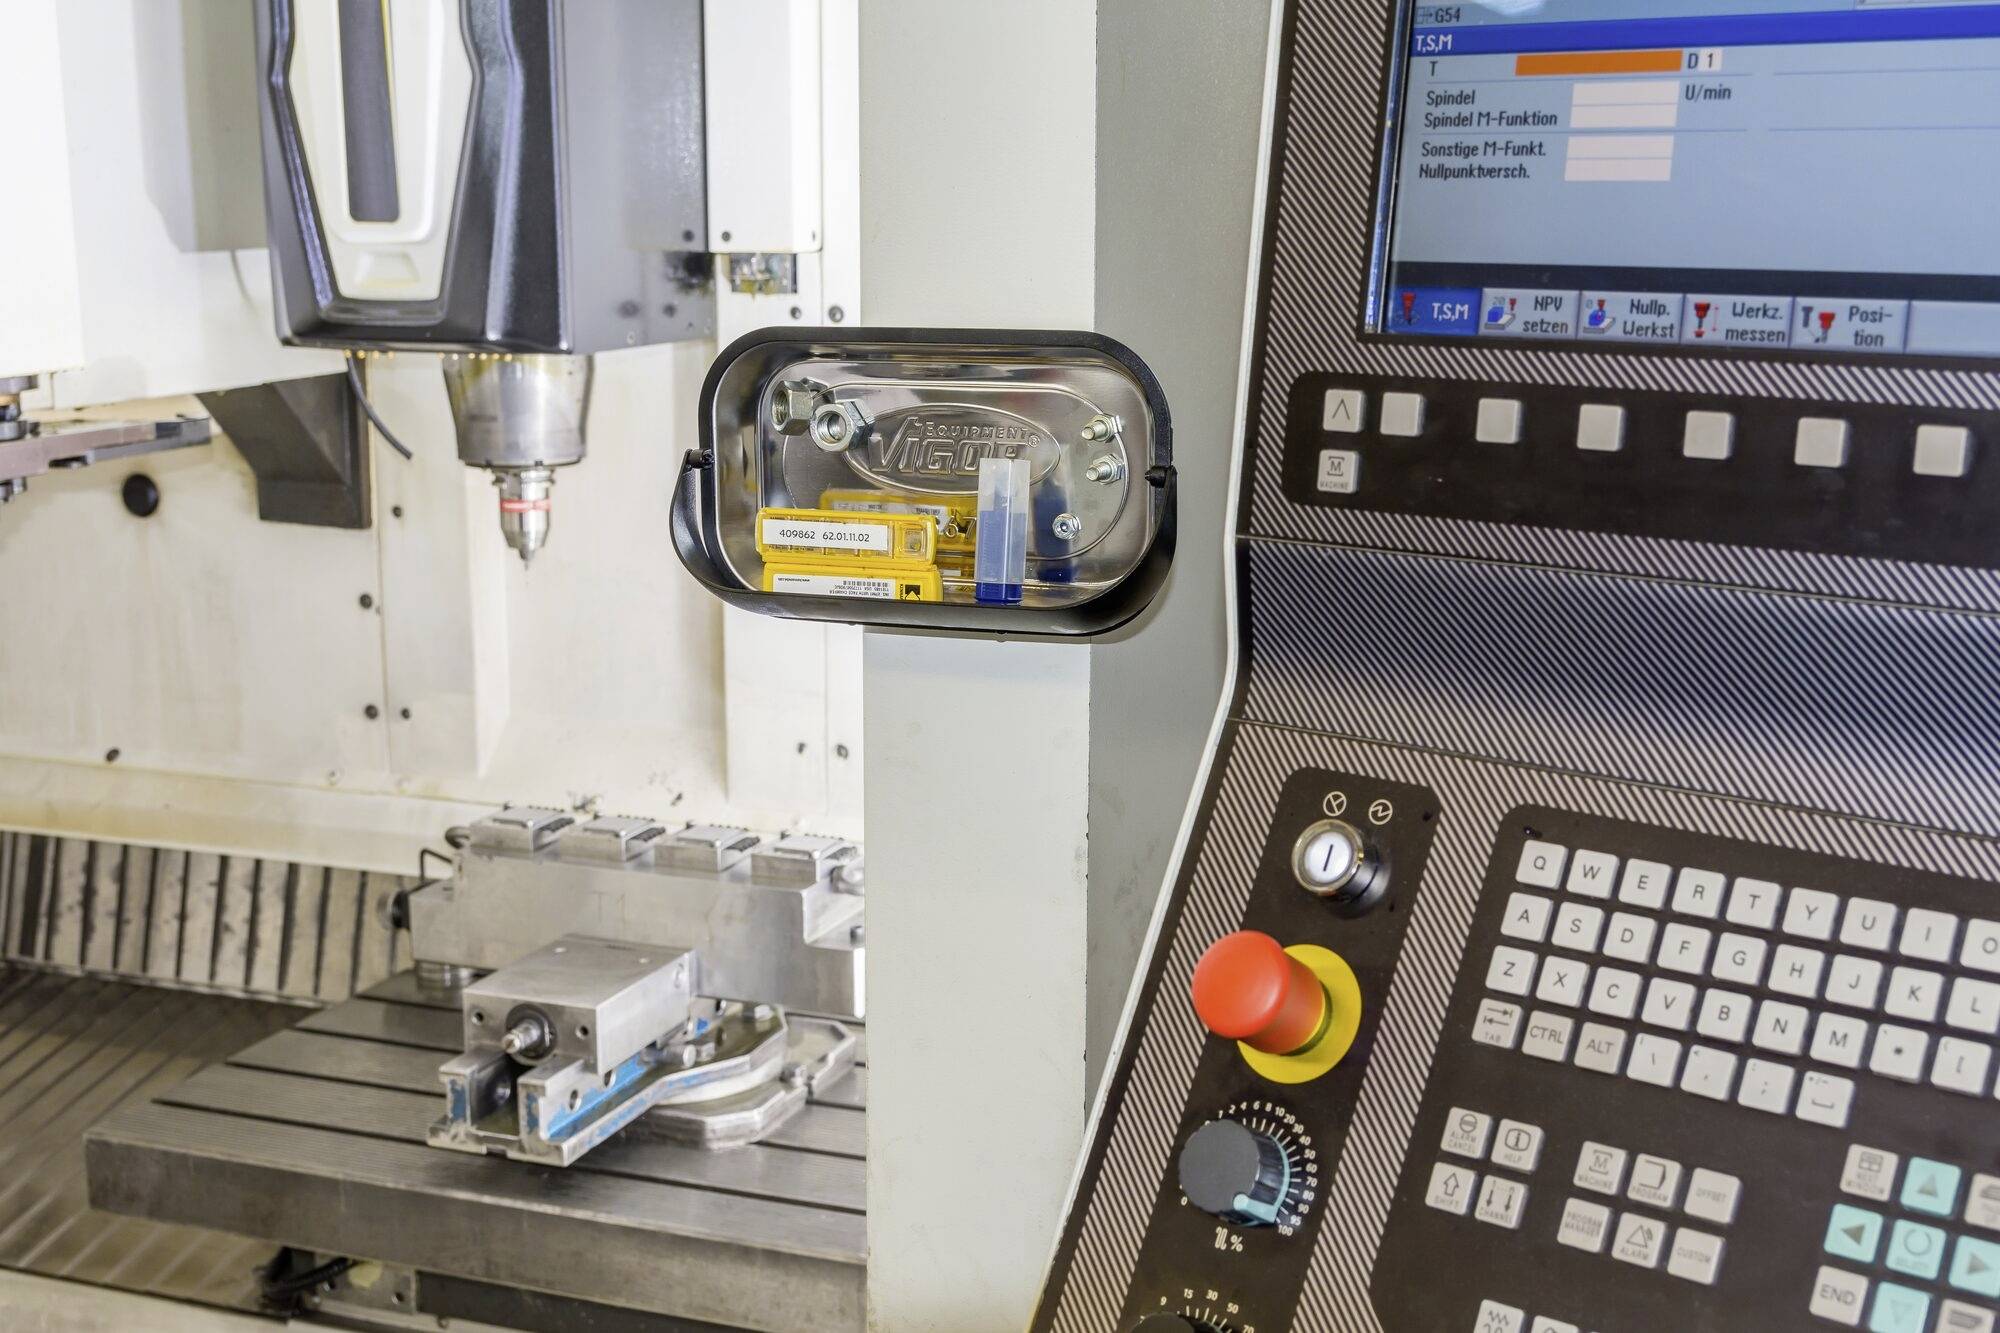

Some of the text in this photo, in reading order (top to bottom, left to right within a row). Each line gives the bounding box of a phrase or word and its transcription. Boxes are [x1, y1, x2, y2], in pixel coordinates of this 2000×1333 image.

[1434, 7, 1461, 24] G54
[1415, 34, 1452, 54] T,S,M
[1429, 60, 1439, 77] T
[1687, 52, 1714, 69] D 1
[1426, 90, 1476, 107] Spindel
[1685, 83, 1732, 102] U/min
[1424, 110, 1558, 129] Spindel M-Funktion
[1421, 140, 1546, 159] Sonstige M-Funkt.
[1419, 163, 1531, 181] Nullpunktversch.
[1431, 302, 1470, 321] T,S,M
[1534, 295, 1563, 312] NPV
[1629, 298, 1670, 317] Nullp.
[1731, 302, 1784, 320] Werkz.
[1848, 305, 1893, 323] Posi-
[1522, 319, 1569, 334] setzen
[1622, 320, 1675, 338] Werkst
[1725, 326, 1786, 343] messen
[1853, 329, 1885, 347] tion
[925, 420, 1029, 440] EQUIPMENT
[778, 528, 871, 543] 409862 62.01.11.02
[1533, 855, 1547, 871] Q
[1583, 864, 1601, 880] W
[1637, 874, 1649, 890] E
[1692, 884, 1706, 900] R
[1749, 893, 1761, 909] T
[1805, 904, 1819, 920] Y
[1861, 914, 1877, 931] U
[1982, 936, 1999, 955] O
[1517, 908, 1981, 1014] A S D F G H J K L
[1503, 961, 1849, 1047] Z X C V B N M
[1529, 1024, 1565, 1045] CTRL
[1584, 1038, 1615, 1054] ALT
[1181, 1100, 1318, 1236] 0 1 2 4 6 8 10 20 30 40 50 60 70 80 90 95 100
[1230, 1235, 1244, 1252] %
[1160, 1295, 1167, 1306] 9
[1183, 1288, 1194, 1299] 15
[1206, 1289, 1218, 1301] 30
[1226, 1302, 1239, 1314] 50
[1819, 1283, 1857, 1306] END
